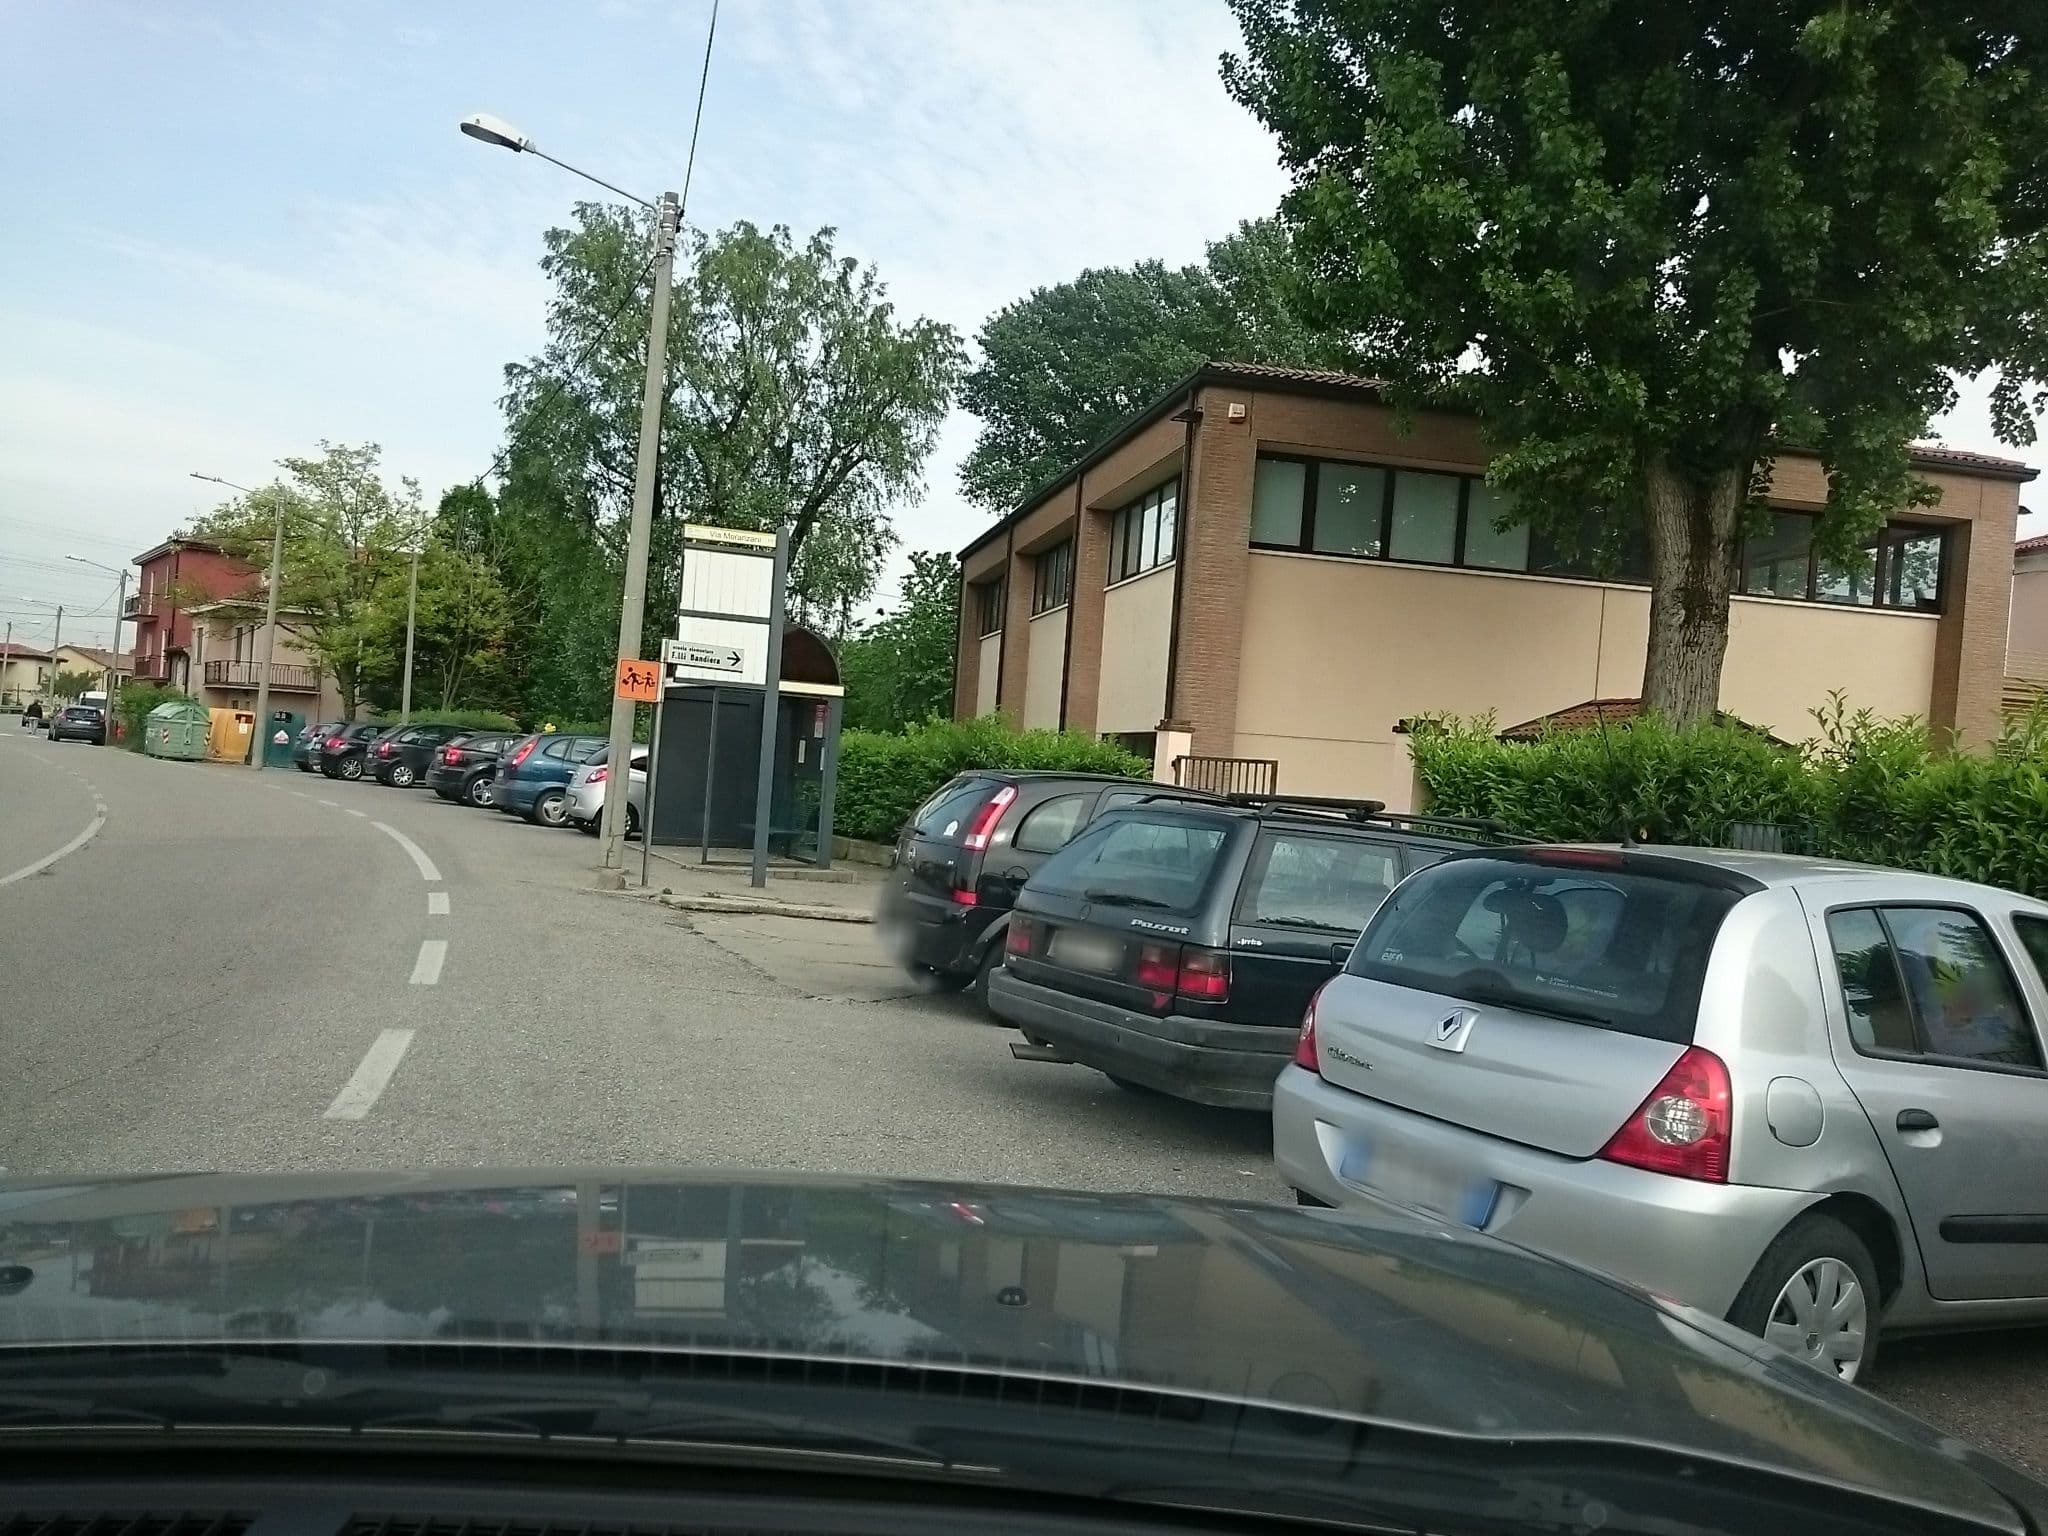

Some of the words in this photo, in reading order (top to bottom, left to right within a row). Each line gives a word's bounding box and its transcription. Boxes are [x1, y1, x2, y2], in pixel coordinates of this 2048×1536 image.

[709, 530, 722, 539] Via
[724, 532, 762, 543] Moranzani
[690, 654, 721, 665] Bandiera
